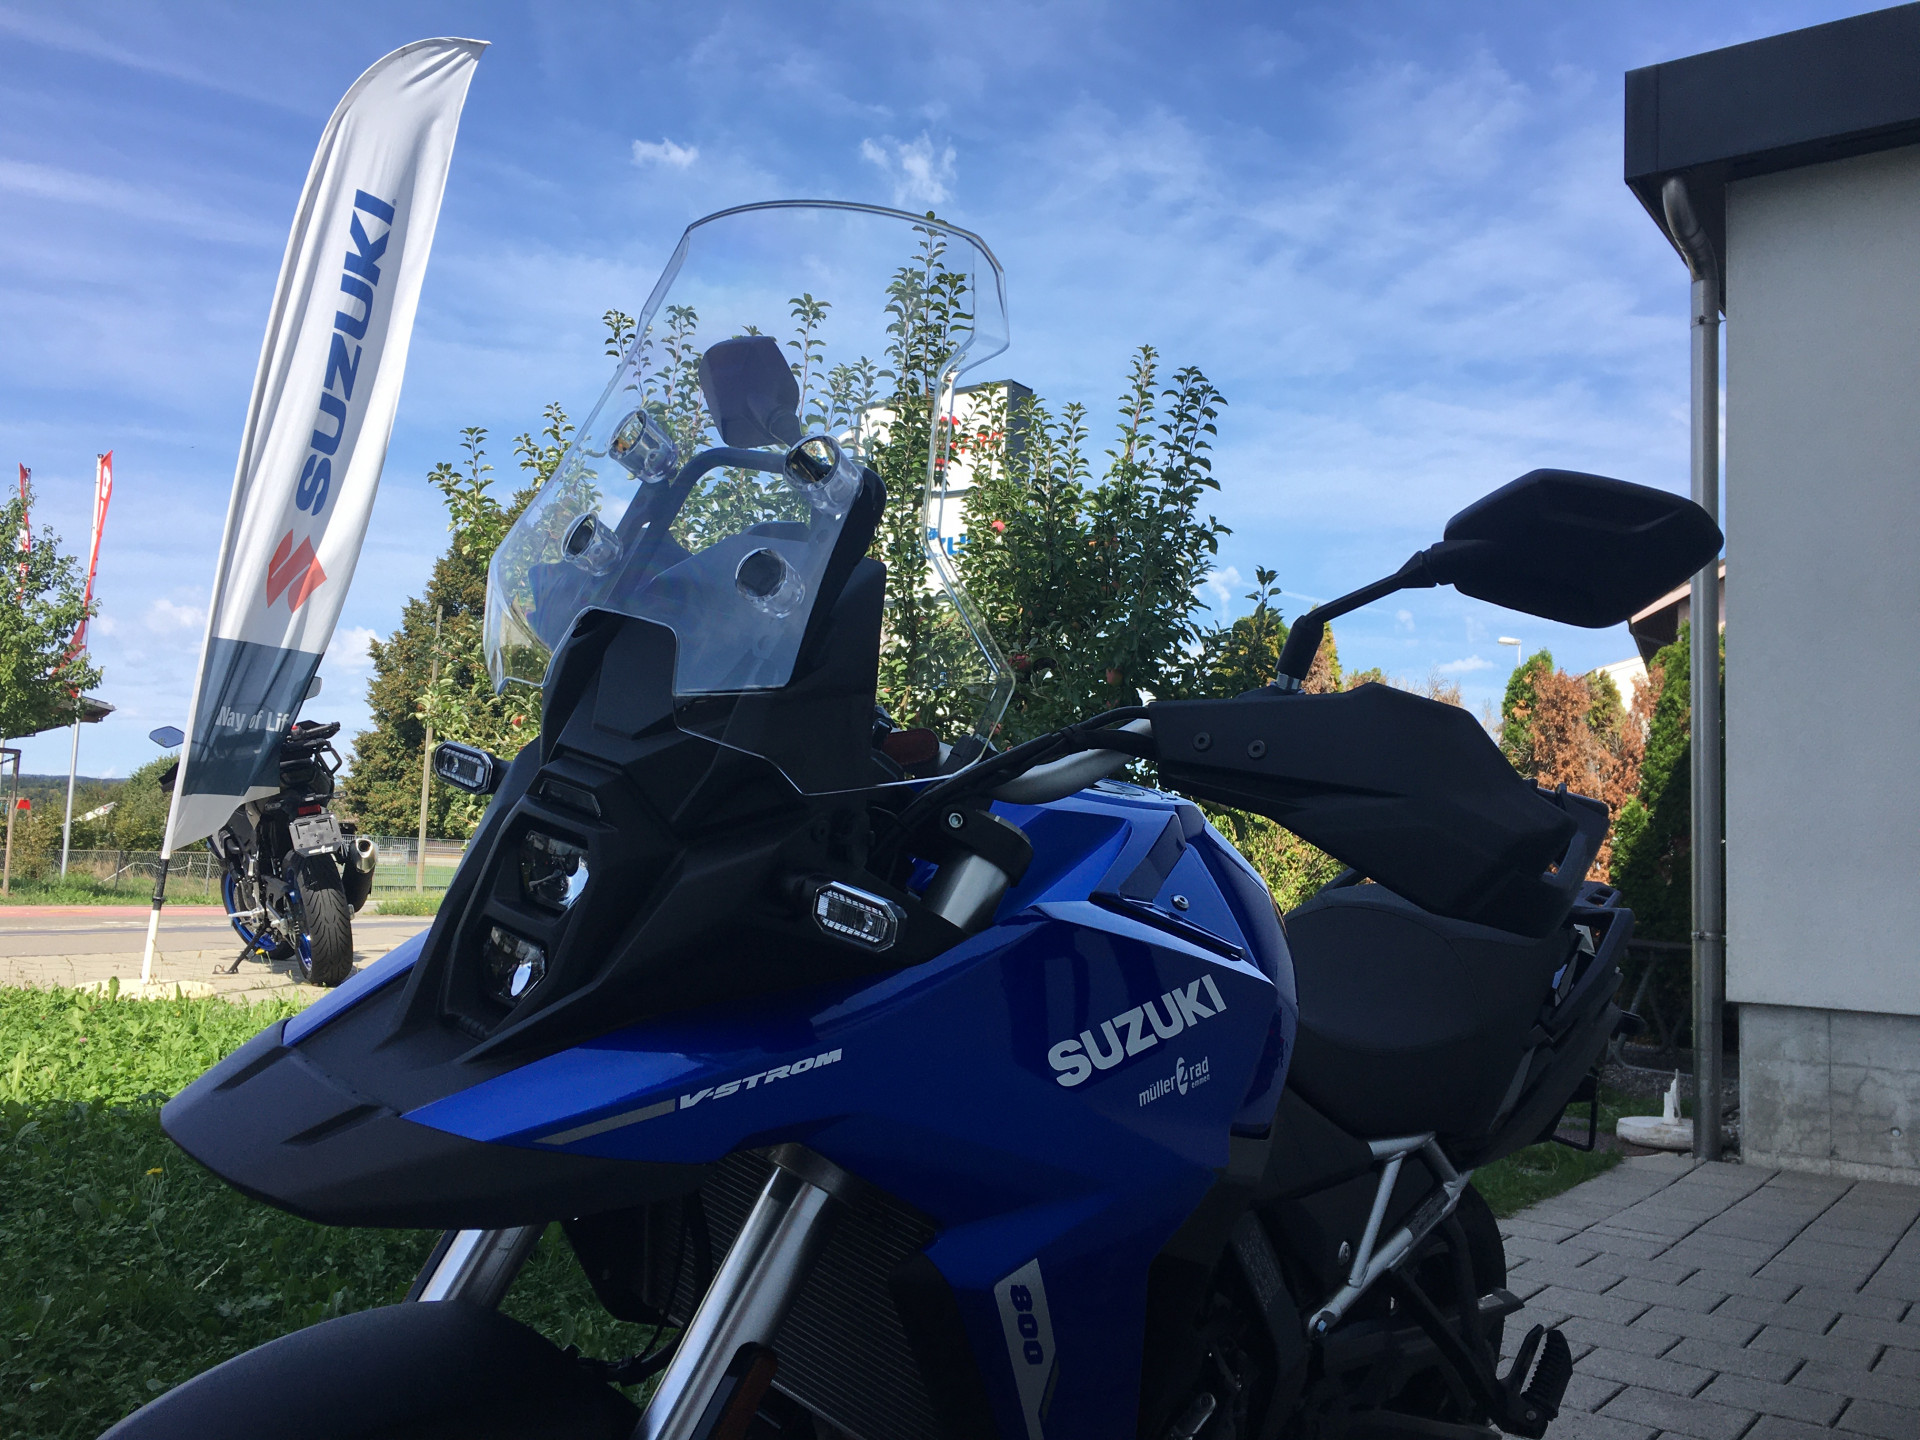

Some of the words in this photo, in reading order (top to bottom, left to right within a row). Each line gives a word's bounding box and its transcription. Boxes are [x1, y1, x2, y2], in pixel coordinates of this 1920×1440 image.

[296, 189, 396, 516] SUZUKI
[248, 709, 264, 730] of
[265, 711, 290, 733] Lif
[1047, 973, 1227, 1088] SUZUKI
[1010, 1284, 1044, 1366] 800
